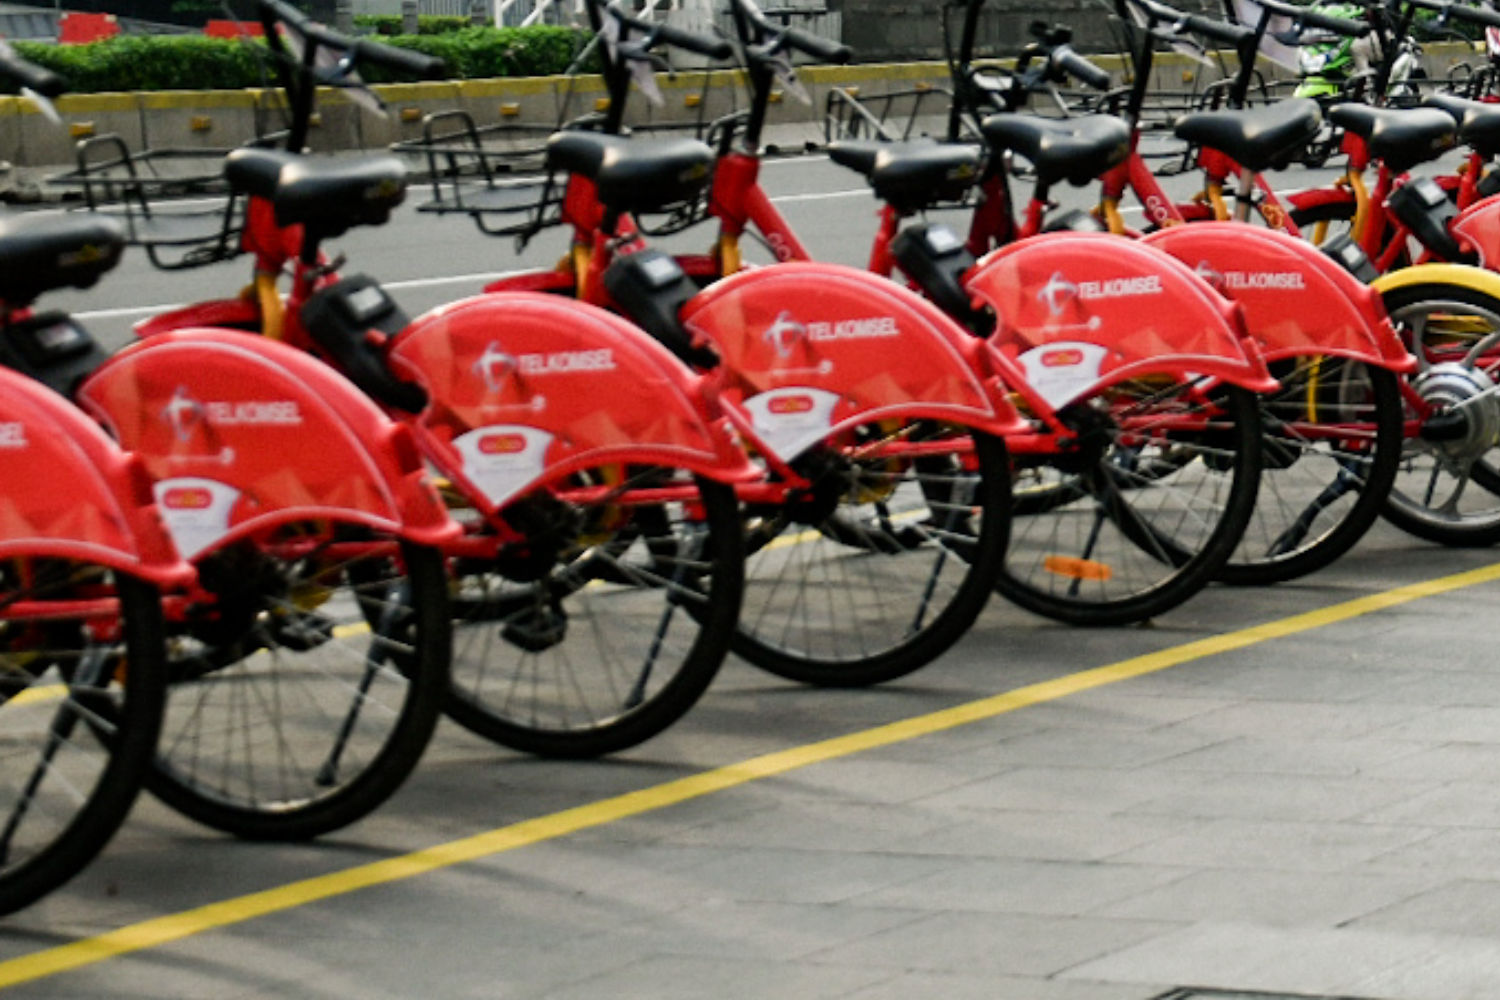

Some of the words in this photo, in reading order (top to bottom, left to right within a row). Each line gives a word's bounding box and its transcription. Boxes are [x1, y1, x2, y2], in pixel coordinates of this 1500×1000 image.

[1077, 275, 1163, 300] TELKOMSEL
[1224, 271, 1306, 290] TELKOMSEL
[806, 317, 900, 342] TELKOMSEL
